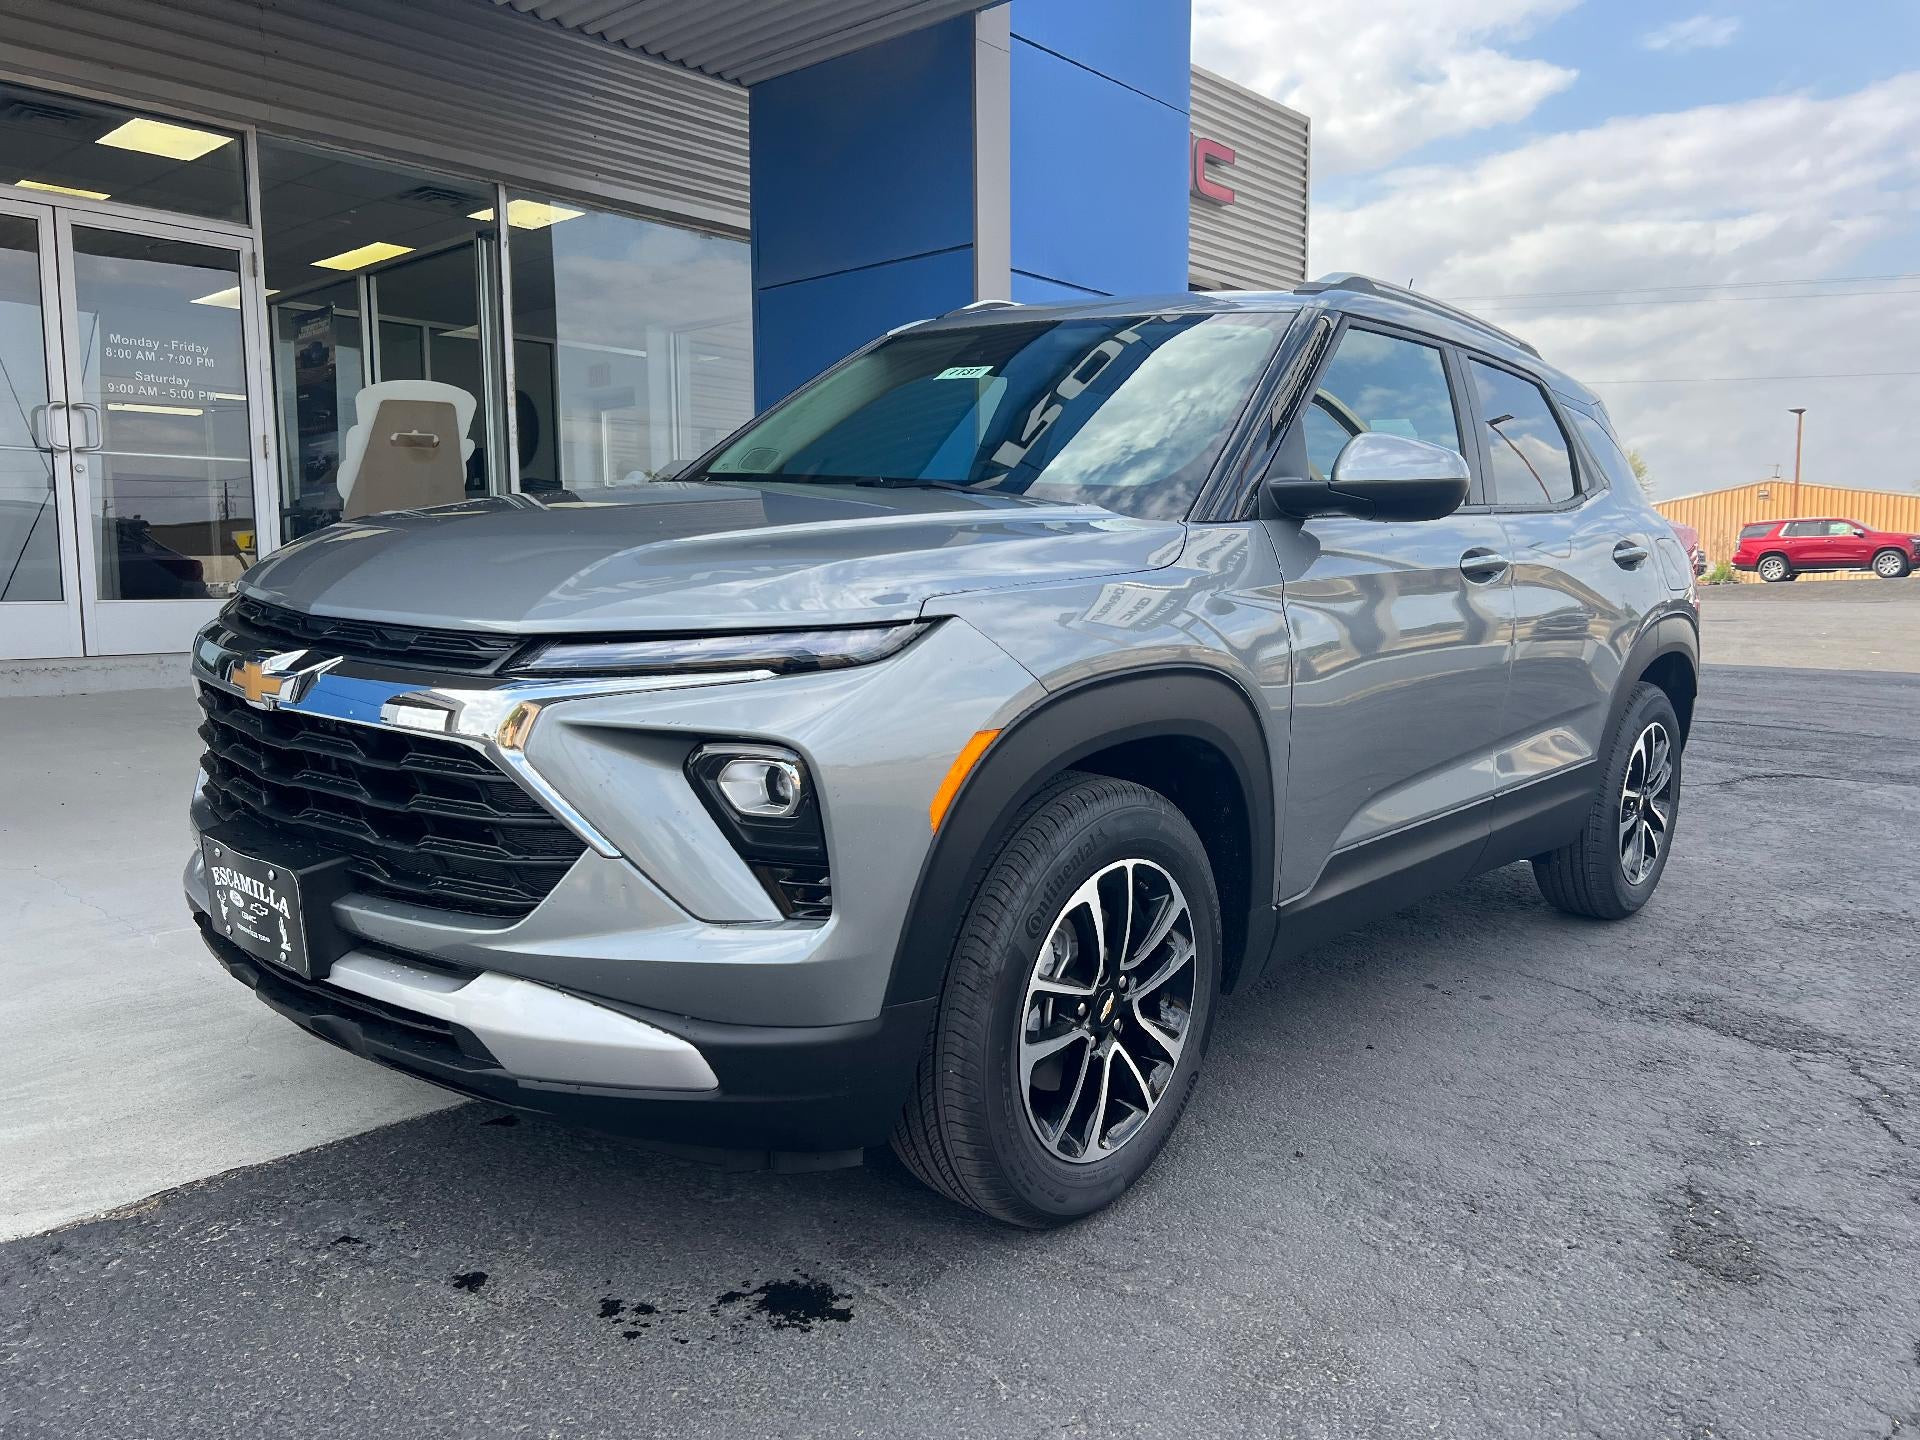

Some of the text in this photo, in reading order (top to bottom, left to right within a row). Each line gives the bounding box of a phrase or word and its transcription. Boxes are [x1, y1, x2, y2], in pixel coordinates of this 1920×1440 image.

[1190, 132, 1235, 205] C
[109, 333, 160, 351] Monday
[171, 340, 209, 356] Friday
[105, 347, 132, 359] 8:00
[136, 350, 156, 362] AM
[167, 353, 192, 366] 7:00
[196, 357, 214, 368] PM
[135, 371, 190, 388] Saturday
[107, 382, 134, 394] 9:00
[138, 385, 158, 397] AM
[169, 388, 194, 400] 5:00
[198, 390, 217, 402] PM
[211, 866, 290, 919] ESCAMILLA
[1025, 833, 1098, 939] Continental
